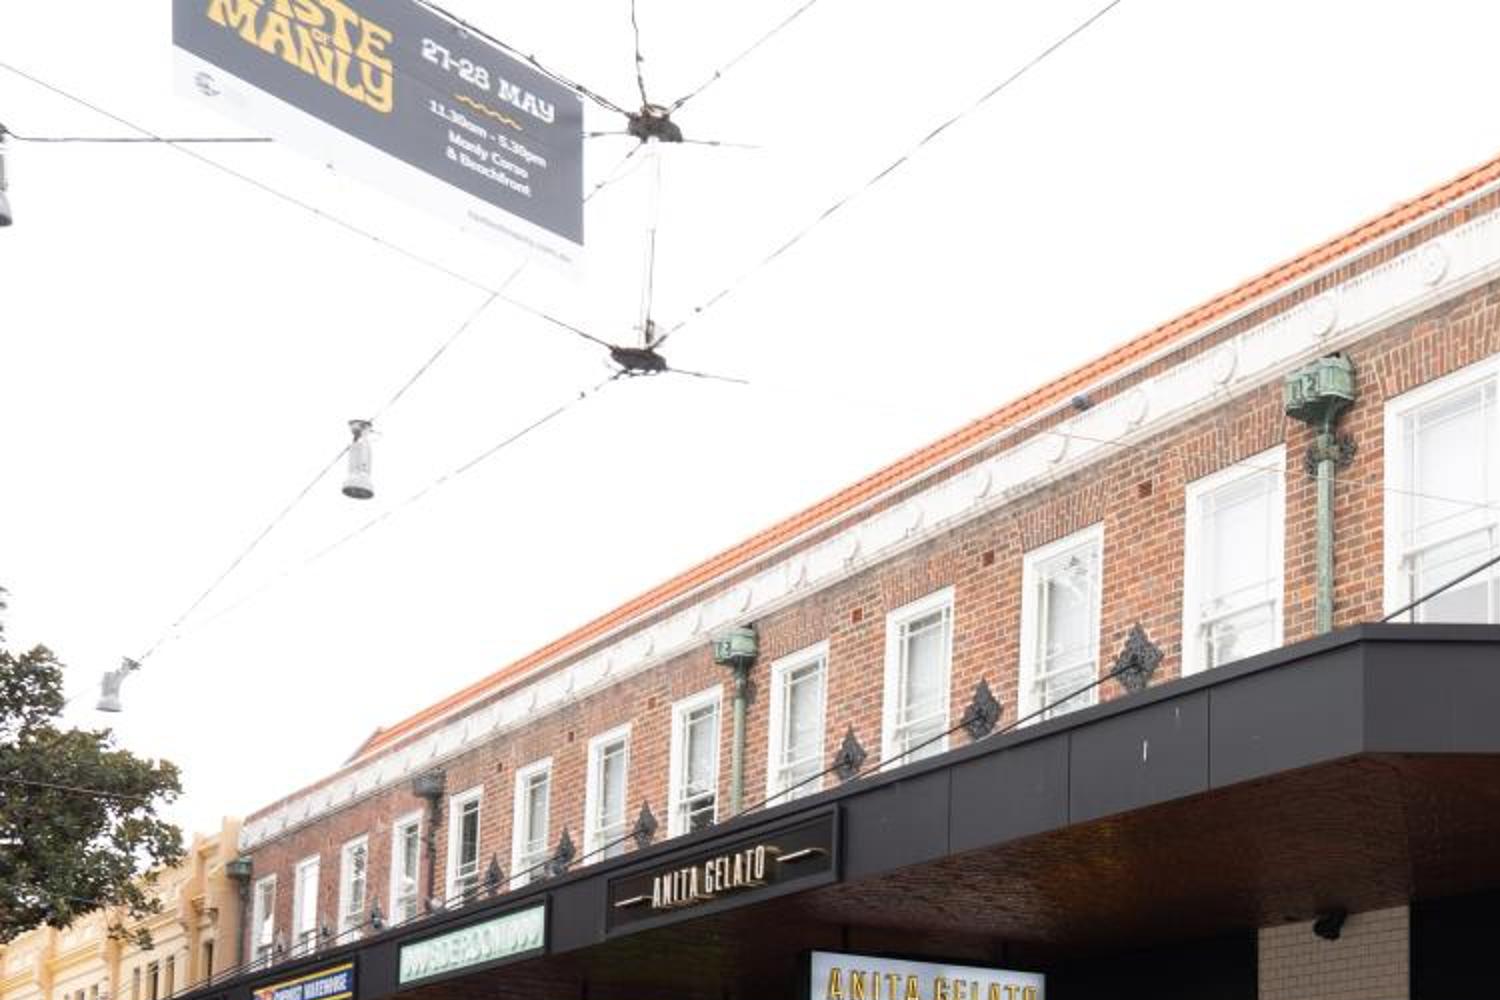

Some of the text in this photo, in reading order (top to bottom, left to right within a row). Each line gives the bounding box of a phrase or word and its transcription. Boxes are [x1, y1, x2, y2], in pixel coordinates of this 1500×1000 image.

[208, 0, 393, 113] MANLY
[422, 38, 555, 124] 27-28 MAY
[652, 845, 765, 909] ANITA GELATO
